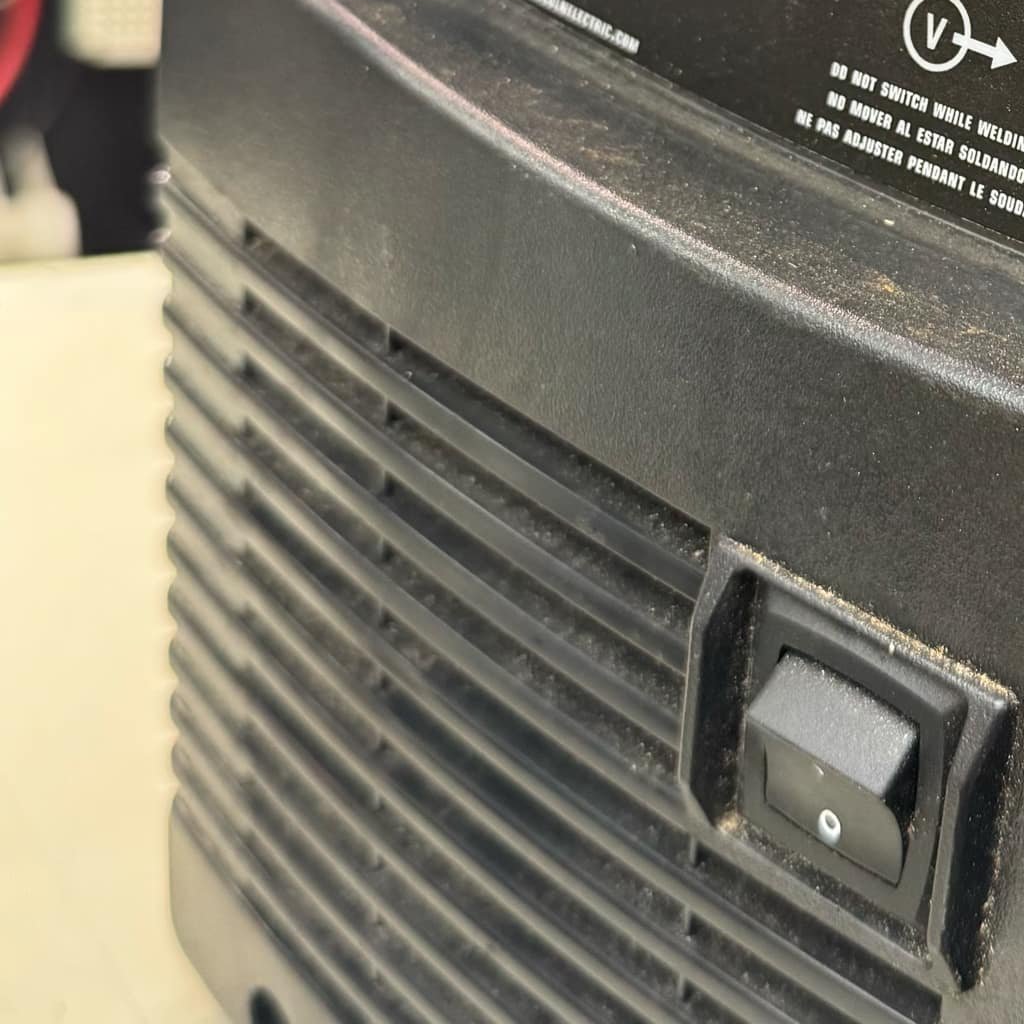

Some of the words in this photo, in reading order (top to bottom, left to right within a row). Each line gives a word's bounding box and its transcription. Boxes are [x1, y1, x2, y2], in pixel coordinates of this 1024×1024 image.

[926, 12, 948, 50] V
[826, 91, 845, 111] NO
[849, 99, 892, 130] MOVER
[896, 119, 911, 138] AL
[916, 127, 955, 155] ESTAR
[830, 62, 847, 81] DO
[852, 69, 877, 93] NOT
[881, 81, 928, 113] SWITCH
[933, 102, 973, 130] WHILE
[794, 109, 813, 129] NE
[816, 118, 840, 141] PAS
[843, 130, 903, 166] ADJUSTER
[907, 155, 966, 191] PENDANT
[969, 180, 985, 199] LE
